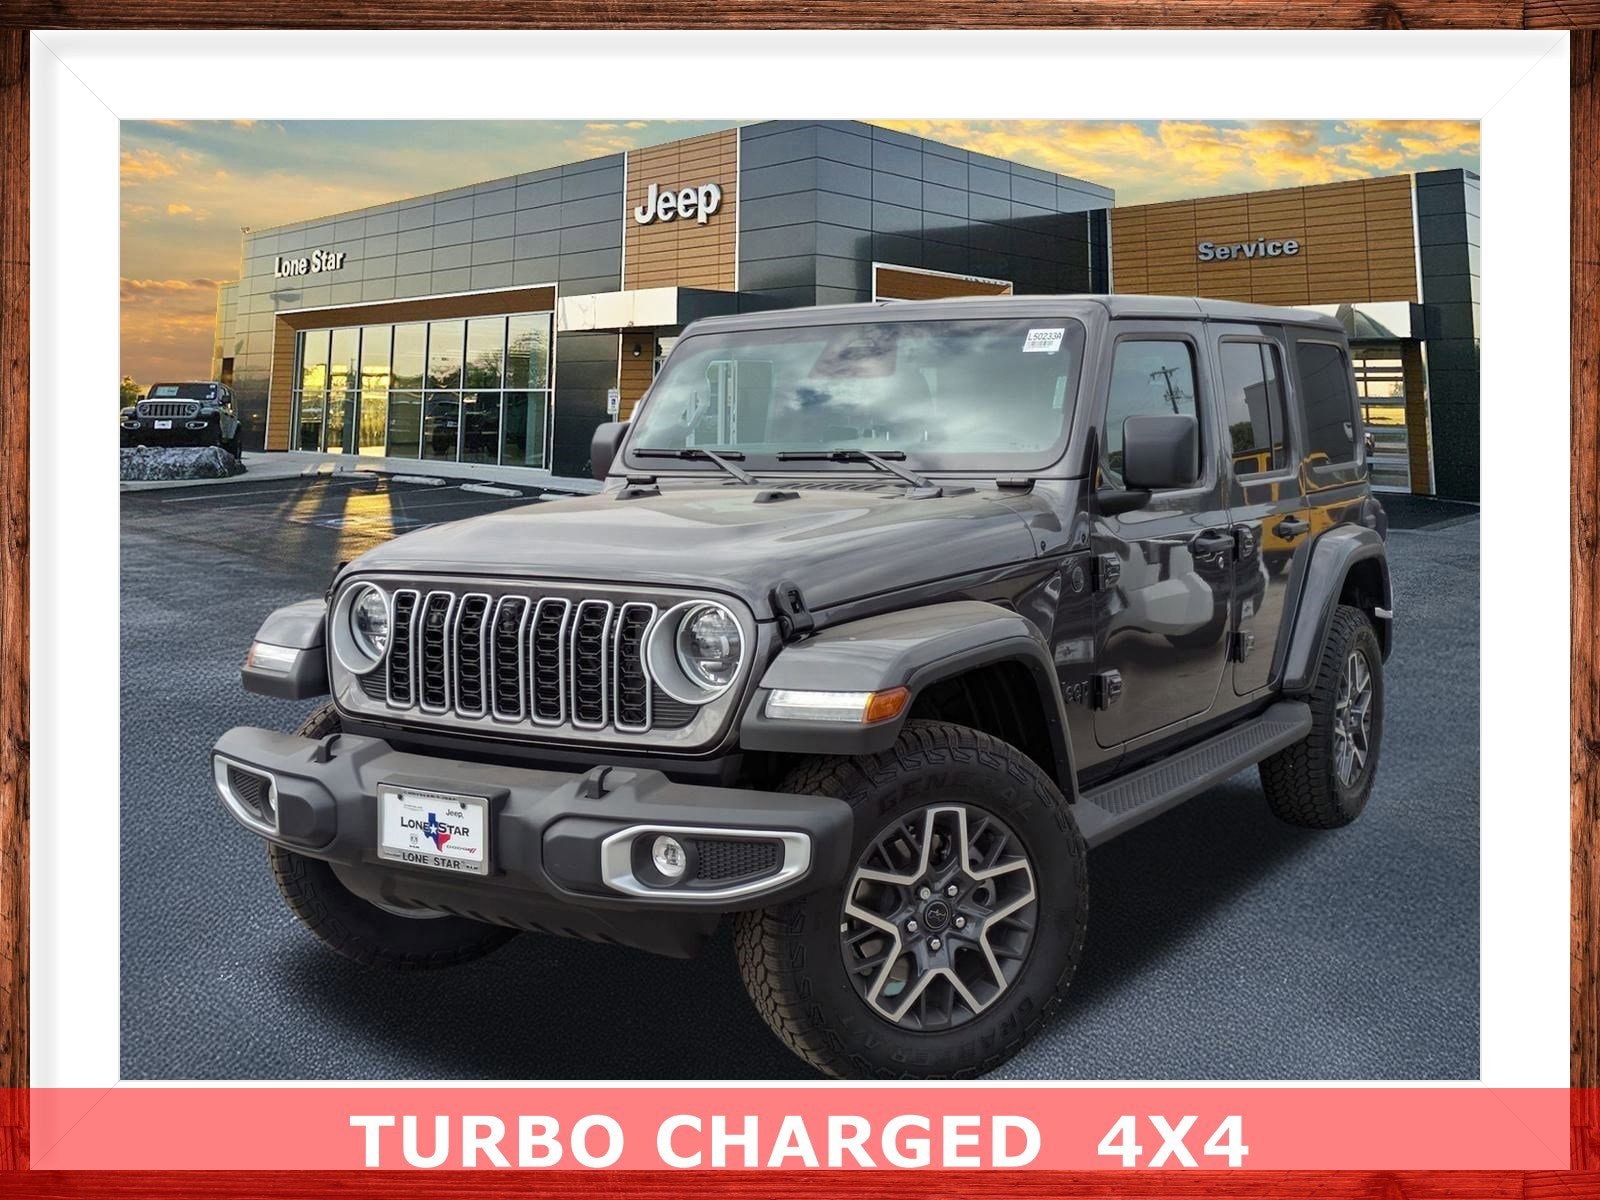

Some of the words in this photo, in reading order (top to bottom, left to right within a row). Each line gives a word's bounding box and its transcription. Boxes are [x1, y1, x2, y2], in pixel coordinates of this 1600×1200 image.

[634, 183, 722, 225] Jeep
[1198, 237, 1299, 261] Service
[275, 257, 309, 278] Lone
[311, 249, 346, 273] Star
[446, 809, 464, 818] Jeep
[400, 816, 430, 832] LONE
[438, 822, 470, 837] STAR
[402, 851, 429, 865] LONE
[433, 856, 461, 870] STAR
